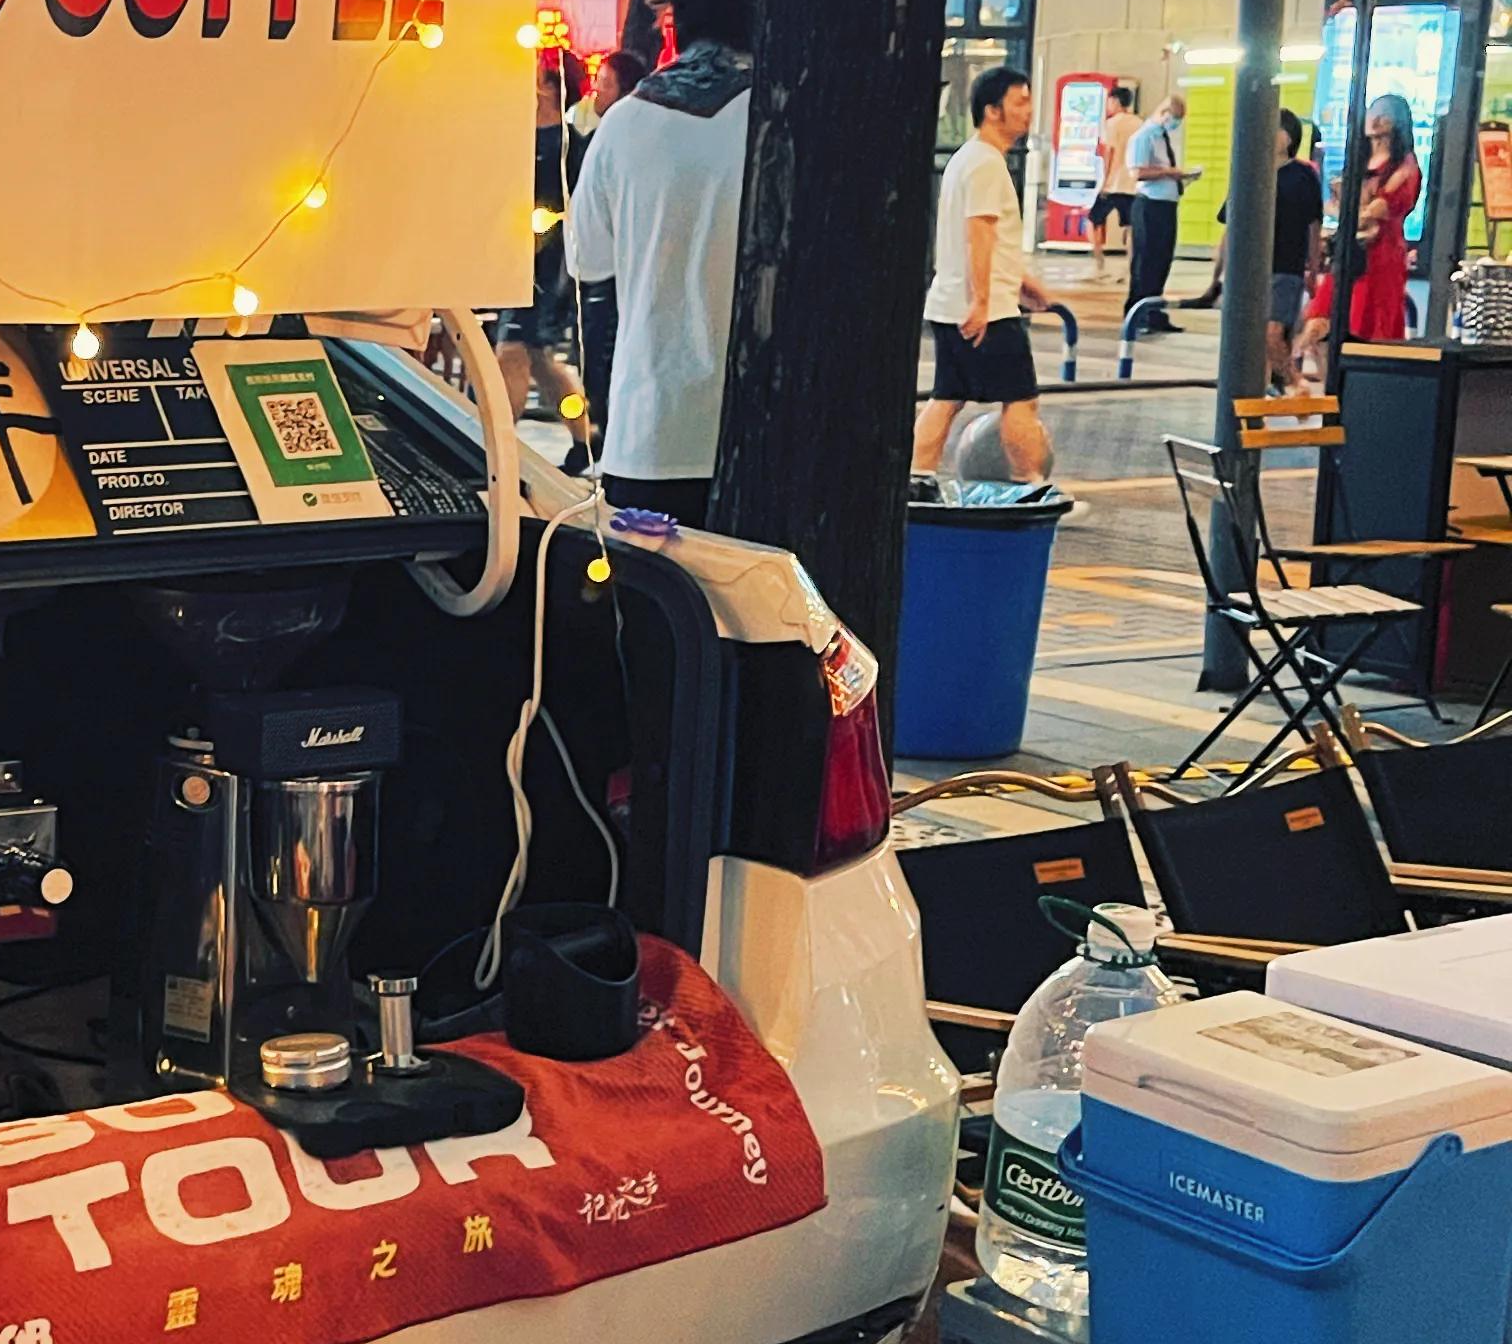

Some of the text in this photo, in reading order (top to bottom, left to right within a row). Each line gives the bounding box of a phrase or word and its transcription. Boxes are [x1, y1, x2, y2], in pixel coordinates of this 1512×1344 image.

[82, 388, 141, 404] SCENE
[88, 449, 128, 465] DATE
[108, 501, 185, 521] DIRECTOR
[300, 725, 366, 750] Marshall
[674, 1041, 768, 1185] Journey
[1168, 1170, 1266, 1224] ICEMASTER
